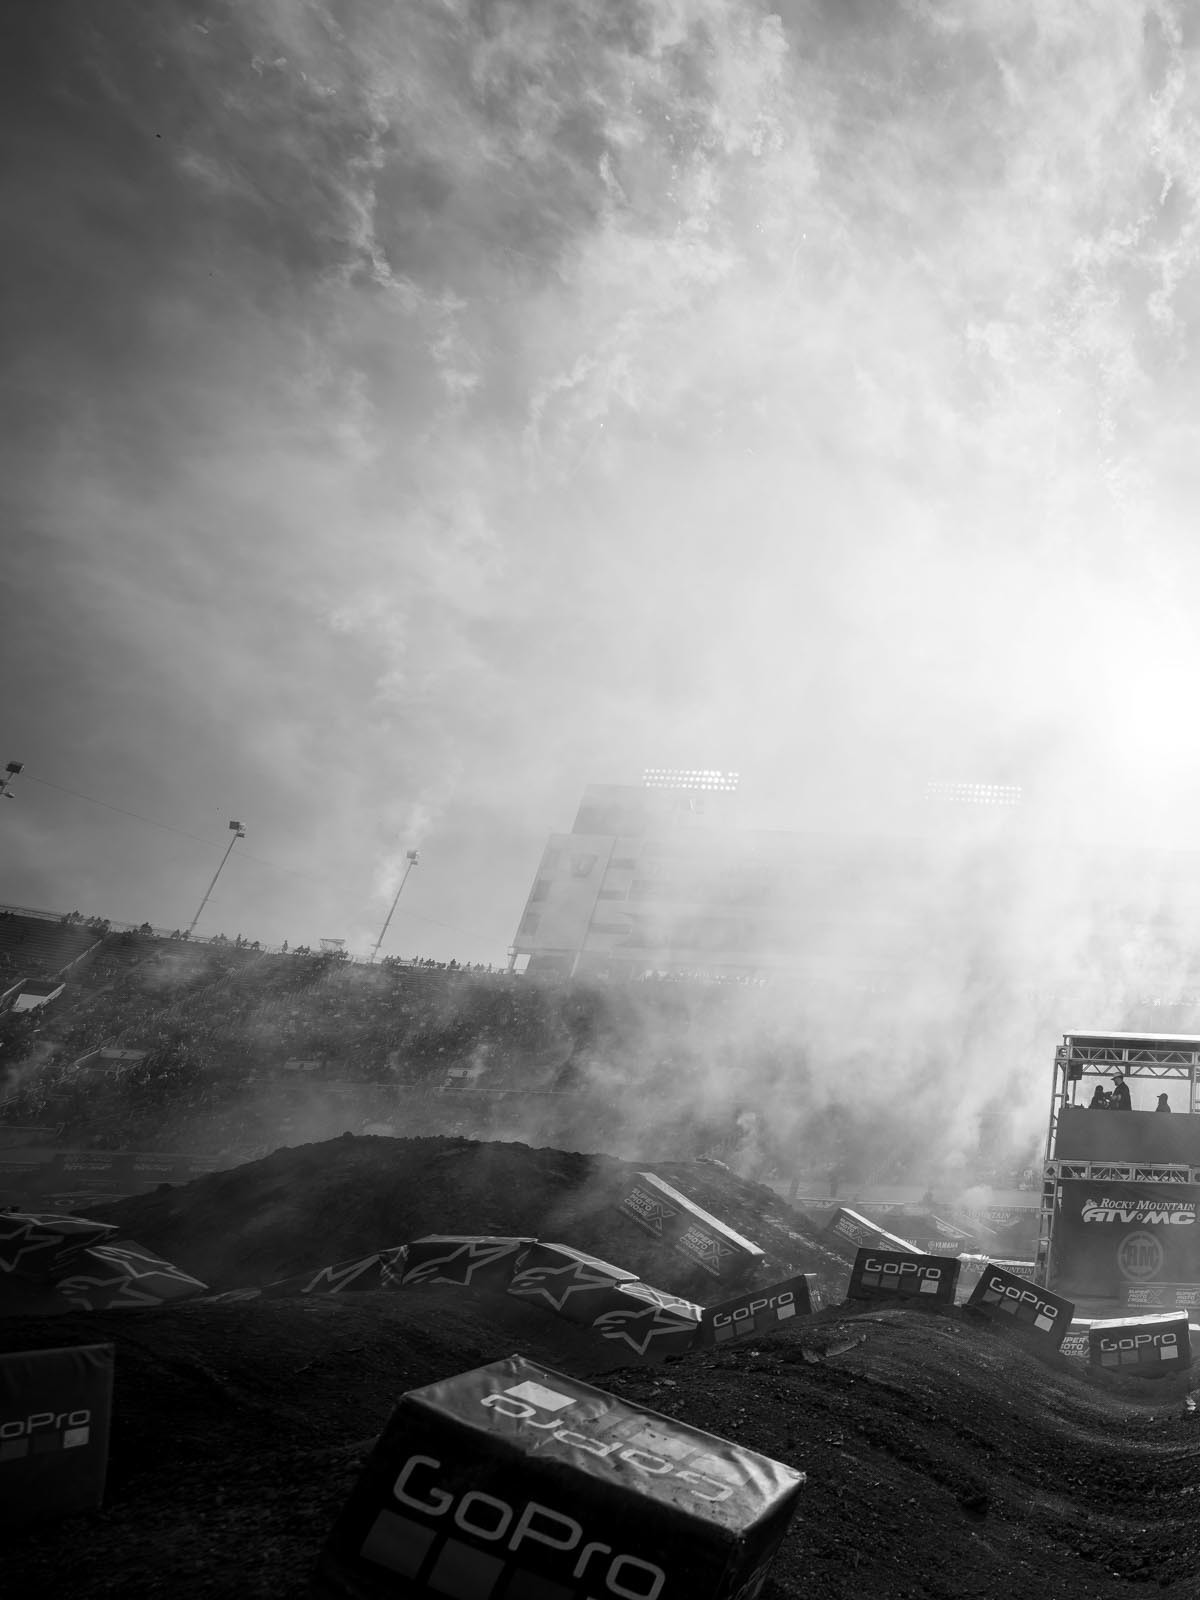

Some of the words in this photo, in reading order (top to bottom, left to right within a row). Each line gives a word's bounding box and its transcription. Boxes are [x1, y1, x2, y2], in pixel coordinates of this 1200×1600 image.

[1100, 1198, 1135, 1209] ROCKY
[1136, 1200, 1196, 1211] MOUNTAIN
[865, 1258, 942, 1279] GoPro
[1001, 1265, 1034, 1275] OUNTAIN
[713, 1291, 794, 1327] GoPro
[989, 1276, 1059, 1318] GoPro
[1100, 1331, 1177, 1350] GoPro
[0, 1408, 91, 1439] oPro
[392, 1454, 666, 1600] GoPro
